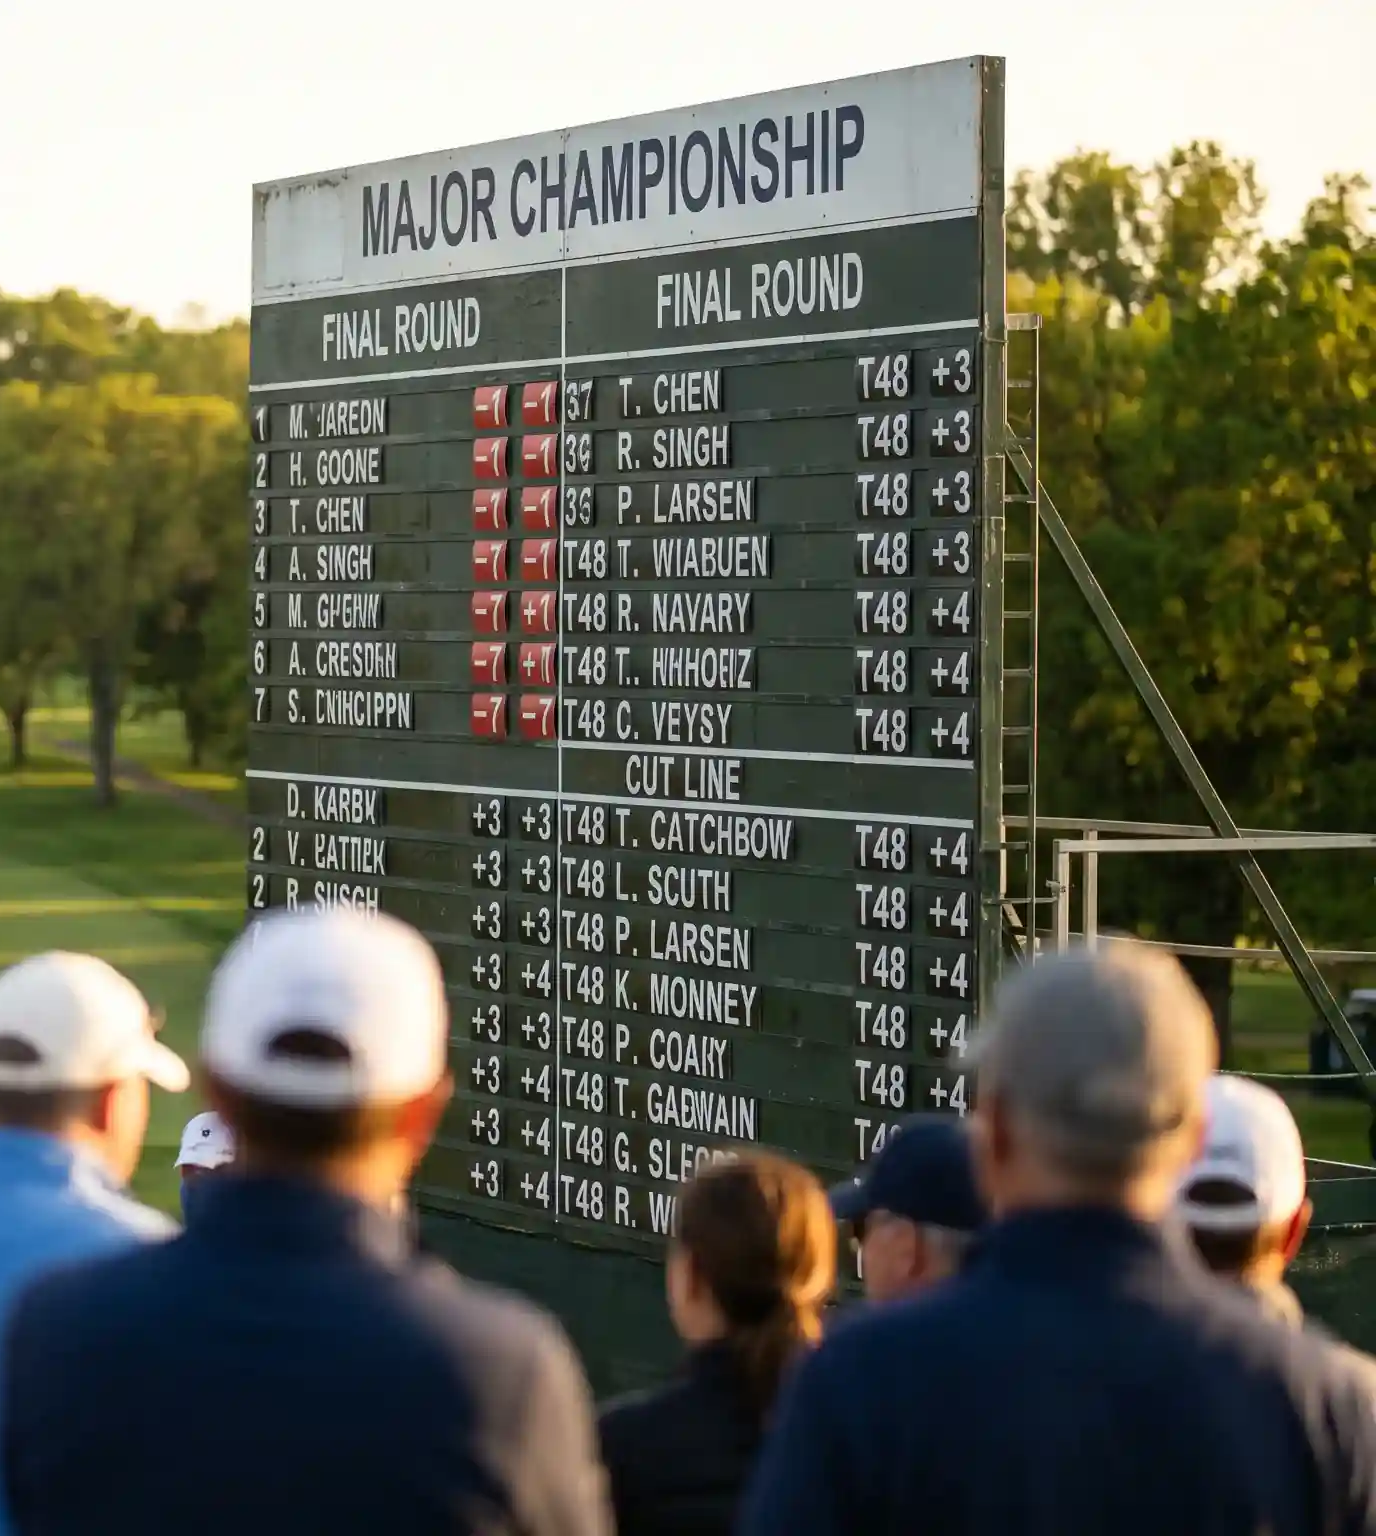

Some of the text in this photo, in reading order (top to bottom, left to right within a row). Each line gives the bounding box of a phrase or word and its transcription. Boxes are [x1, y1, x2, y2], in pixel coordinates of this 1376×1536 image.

[362, 104, 865, 257] MAJOR CHAMPIONSHIP
[657, 252, 864, 328] FINAL ROUND
[323, 297, 481, 362] FINAL ROUND
[619, 377, 641, 417] T.
[653, 370, 720, 415] CHEN
[858, 354, 908, 399] T48
[932, 349, 971, 393] +3
[255, 404, 265, 441] 1
[289, 403, 308, 439] M.
[476, 387, 501, 425] -1
[524, 383, 551, 422] -1
[256, 437, 551, 488] 2 H. GOONE -1 -1
[618, 431, 640, 470] R.
[653, 426, 729, 469] SINGH
[857, 413, 908, 457] T48
[932, 409, 971, 453] +3
[255, 499, 265, 534] 3
[289, 499, 306, 533] T.
[316, 496, 365, 533] CHEN
[524, 488, 551, 528] -1
[618, 485, 641, 525] P.
[653, 480, 752, 524] LARSEN
[857, 473, 908, 516] T48
[932, 470, 971, 513] +3
[255, 546, 266, 580] 4
[289, 546, 307, 581] A.
[316, 545, 372, 581] SINGH
[563, 531, 970, 579] T48 T. WIABUEN T48 +3
[254, 593, 265, 628] 5
[288, 593, 308, 628] M.
[474, 594, 504, 632] -7
[563, 591, 970, 634] T48 R. NAYARY T48 +4
[254, 640, 265, 676] 6
[288, 641, 307, 676] A.
[474, 646, 503, 682] -7
[563, 647, 607, 686] T48
[856, 650, 907, 693] T48
[931, 651, 969, 694] +4
[255, 688, 265, 723] 7
[288, 689, 307, 724] S.
[474, 696, 504, 734] -7
[522, 698, 553, 736] -7
[563, 699, 970, 755] T48 C. VEYSY T48 +4
[625, 754, 741, 801] CUT LINE
[287, 783, 306, 819] D.
[472, 799, 501, 836] +3
[522, 802, 552, 840] +3
[253, 827, 264, 861] 2
[287, 830, 305, 866] V.
[473, 850, 502, 887] +3
[522, 855, 552, 892] +3
[562, 803, 968, 875] T48 T. CATCHBOW T48 +4
[253, 874, 264, 908] 2
[473, 902, 501, 939] +3
[522, 907, 552, 945] +3
[562, 857, 968, 937] T48 L. SCUTH T48 +4
[472, 953, 552, 998] +3 +4
[561, 910, 968, 998] T48 P. LARSEN T48 +4
[471, 1004, 551, 1050] +3 +3
[562, 962, 968, 1058] T48 K. MONNEY T48 +4
[471, 1055, 551, 1103] +3 +4
[562, 1015, 604, 1059] T48
[615, 1023, 638, 1065] P.
[855, 1059, 905, 1108] T48
[930, 1075, 967, 1118] +4
[561, 1068, 604, 1113] T48
[614, 1077, 637, 1119] T.
[471, 1107, 551, 1156] +3 +4
[561, 1121, 604, 1166] T48
[614, 1131, 638, 1174] G.
[470, 1160, 550, 1209] +3 +4
[560, 1174, 604, 1220] T48
[615, 1185, 637, 1228] R.
